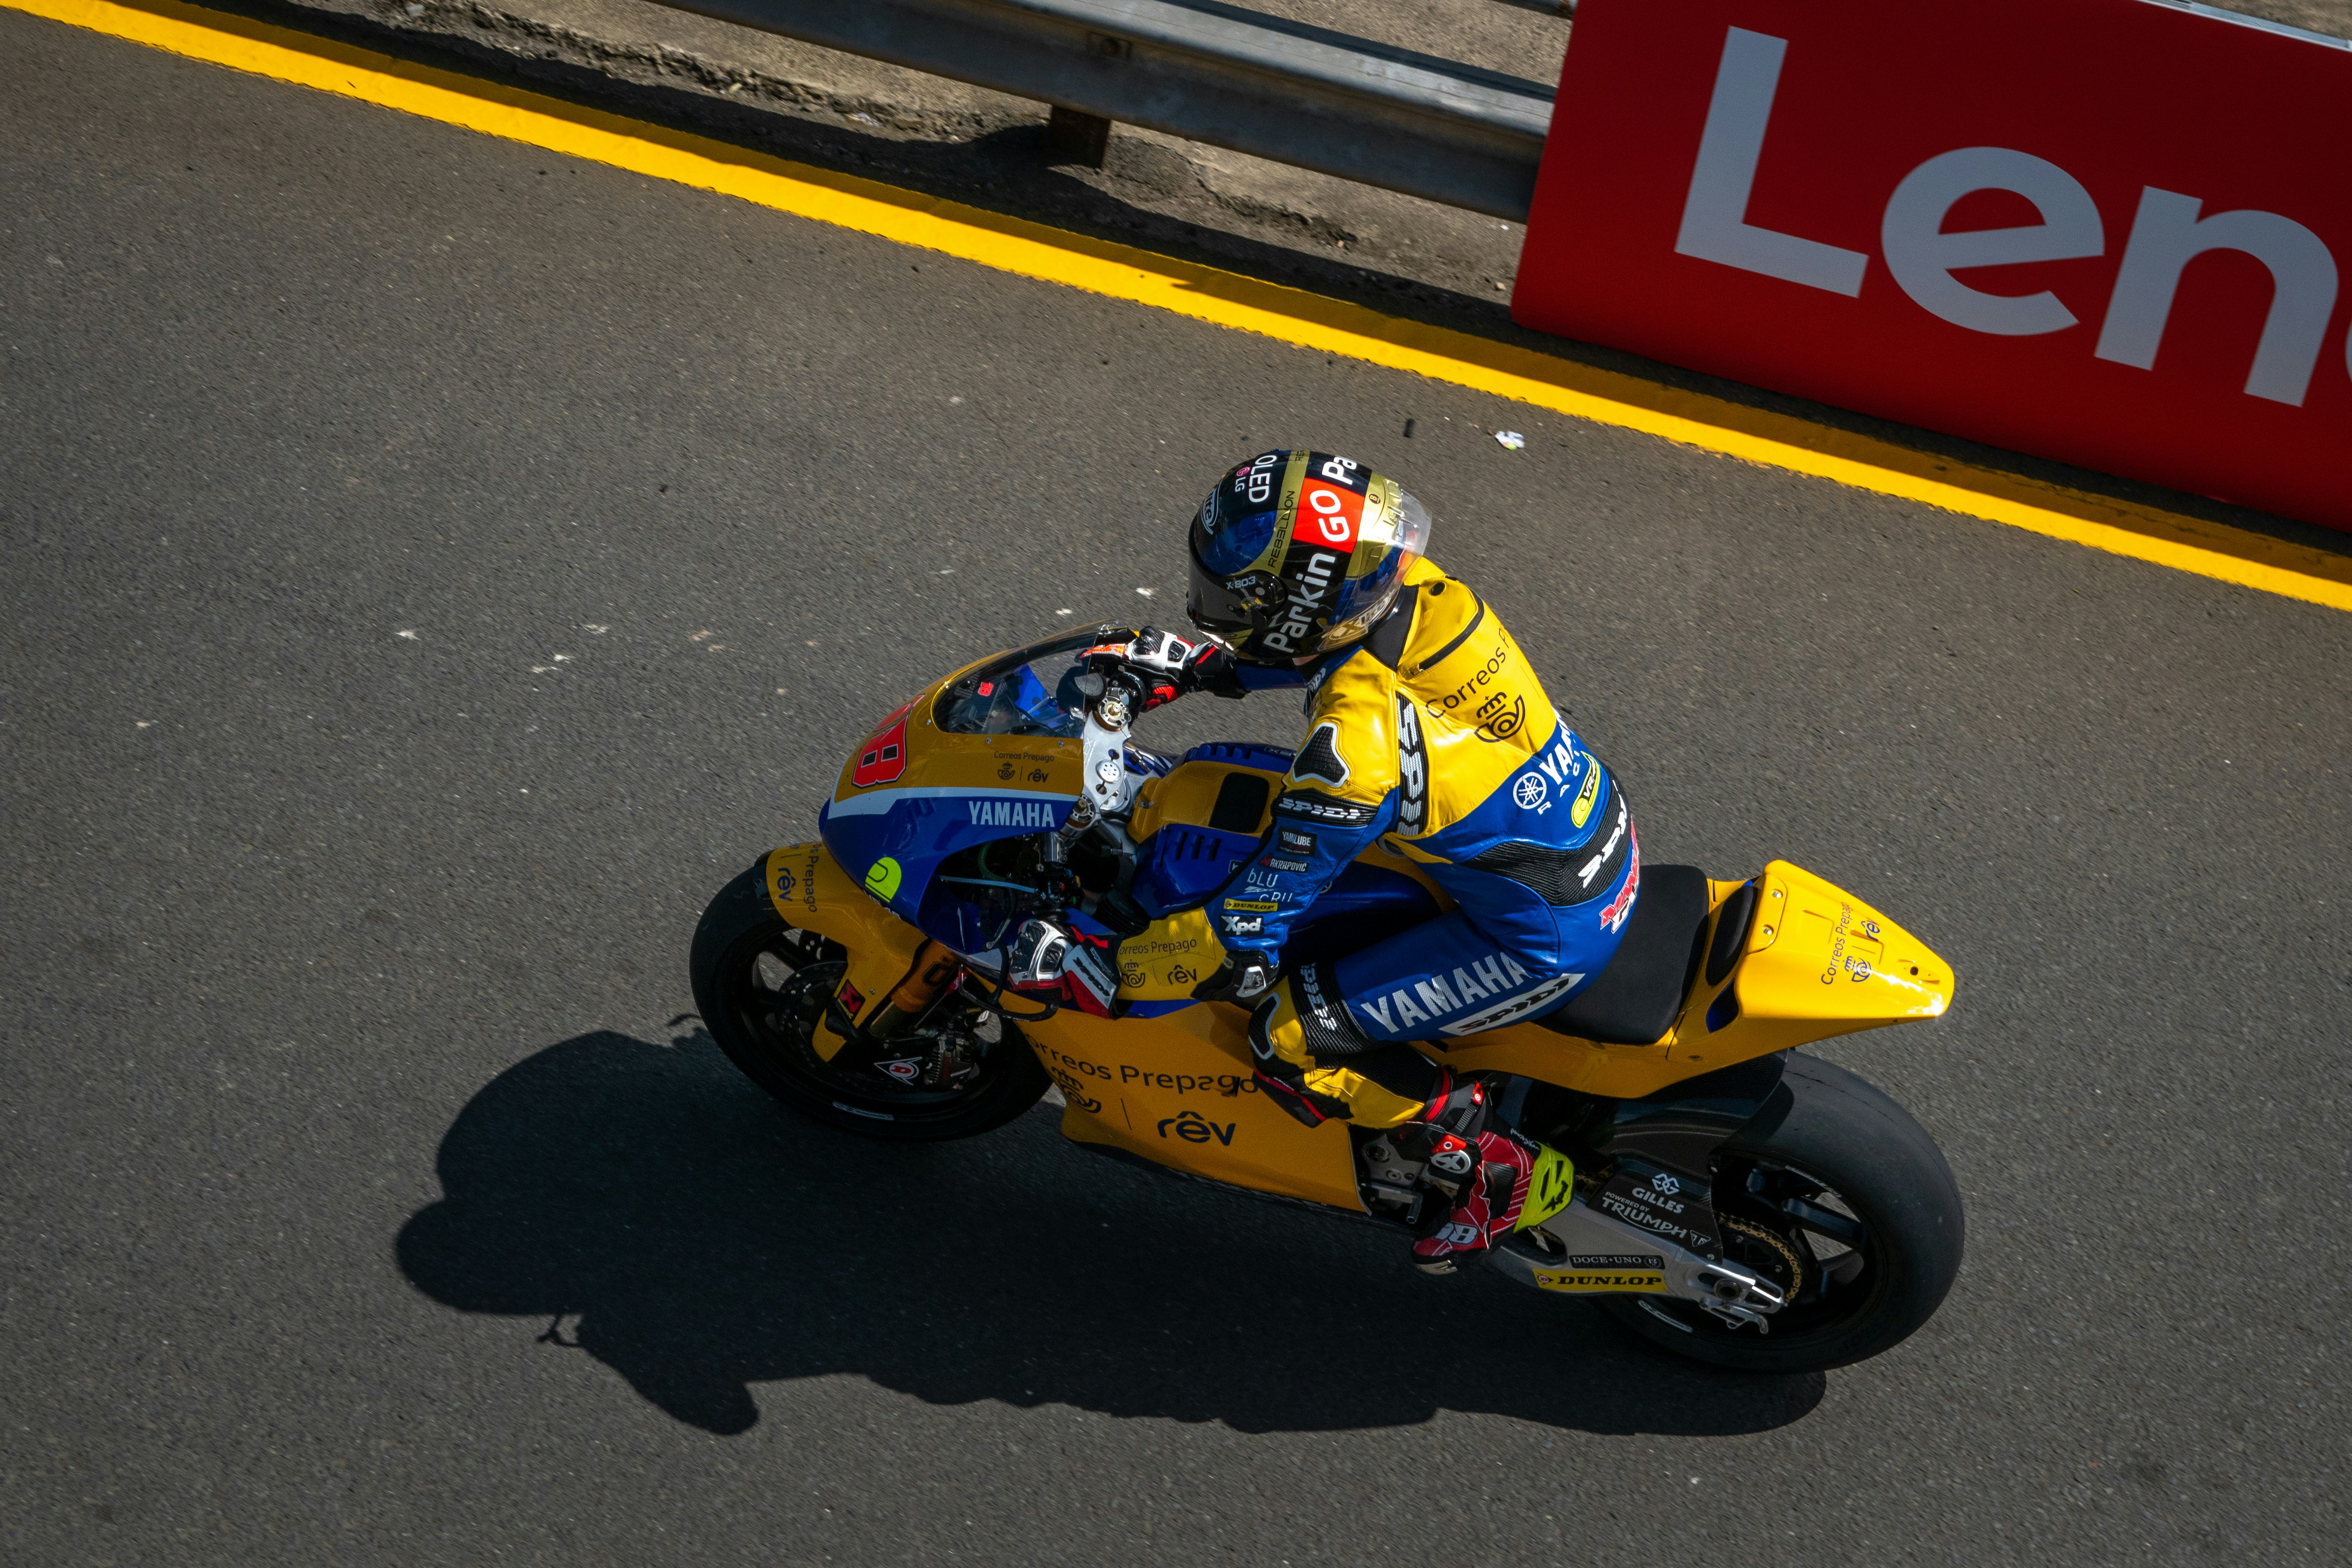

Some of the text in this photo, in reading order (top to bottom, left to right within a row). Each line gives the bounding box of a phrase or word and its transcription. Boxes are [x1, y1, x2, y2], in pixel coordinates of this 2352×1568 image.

[1674, 25, 2352, 408] Len
[1235, 476, 1245, 493] LG
[1249, 455, 1277, 503] OLED
[1225, 576, 1256, 589] X-803
[1263, 553, 1336, 653] Parkin
[1309, 490, 1350, 542] GO
[1426, 647, 1506, 719] Correos
[994, 751, 1054, 763] Correos Prepago
[1027, 768, 1049, 782] rêv
[968, 801, 1055, 827] YAMAHA
[1279, 797, 1360, 819] SPIDI
[777, 867, 796, 902] rêv
[802, 856, 820, 912] Prepago
[1221, 915, 1263, 935] Xpd
[1119, 939, 1197, 955] orreos Prepago
[1821, 937, 1846, 985] Correos
[1167, 964, 1197, 986] rêv
[1360, 952, 1533, 1034] YAMAHA
[1025, 1033, 1258, 1098] orreos Prepago
[1157, 1111, 1236, 1146] rêv
[1604, 1191, 1640, 1208] POWERED
[1632, 1187, 1685, 1214] GILLES
[1602, 1196, 1687, 1239] TRIUMPH
[1572, 1256, 1642, 1264] DOCE+UNO
[1557, 1276, 1662, 1286] DUNLOP
